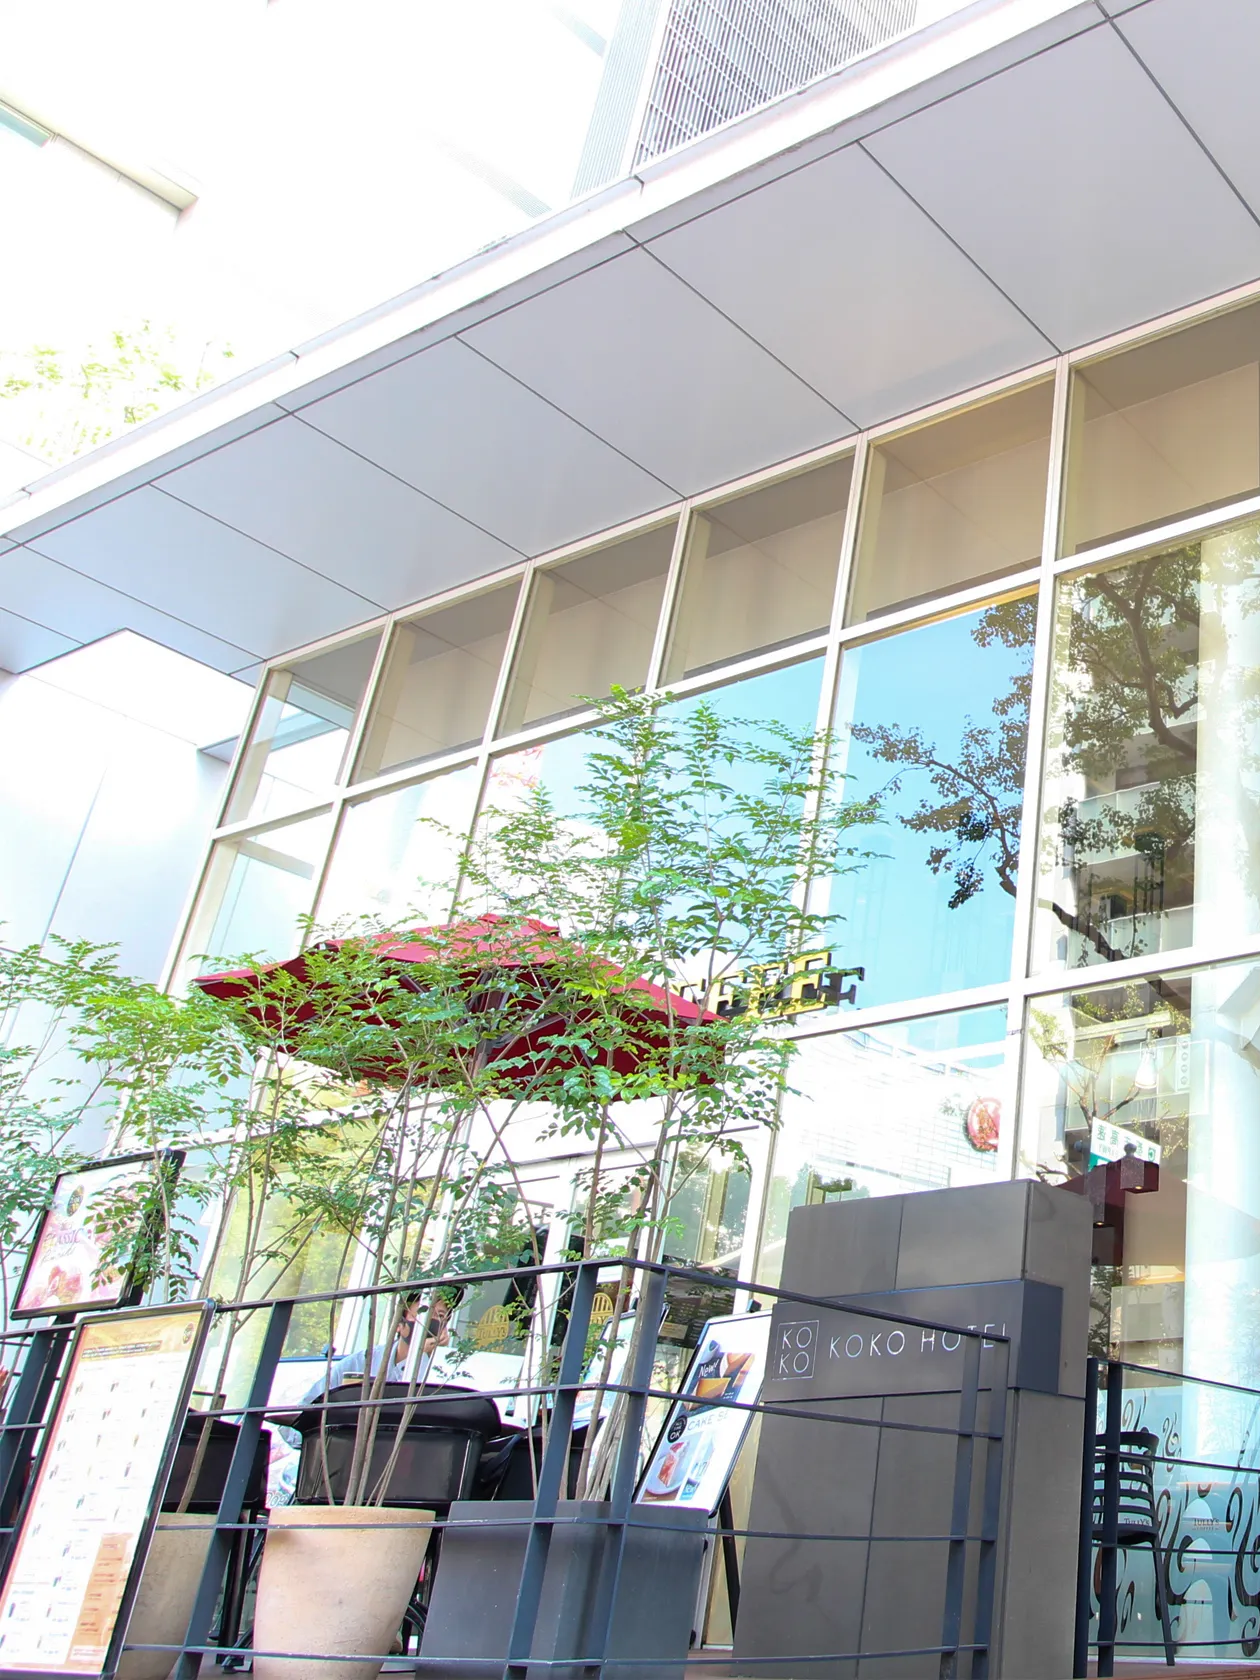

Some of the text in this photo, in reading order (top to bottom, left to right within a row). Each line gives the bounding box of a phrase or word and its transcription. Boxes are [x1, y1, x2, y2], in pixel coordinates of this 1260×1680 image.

[781, 1326, 813, 1350] KO
[829, 1323, 1008, 1359] KOKO HOE
[778, 1351, 810, 1375] KO
[687, 1413, 715, 1431] CAKE
